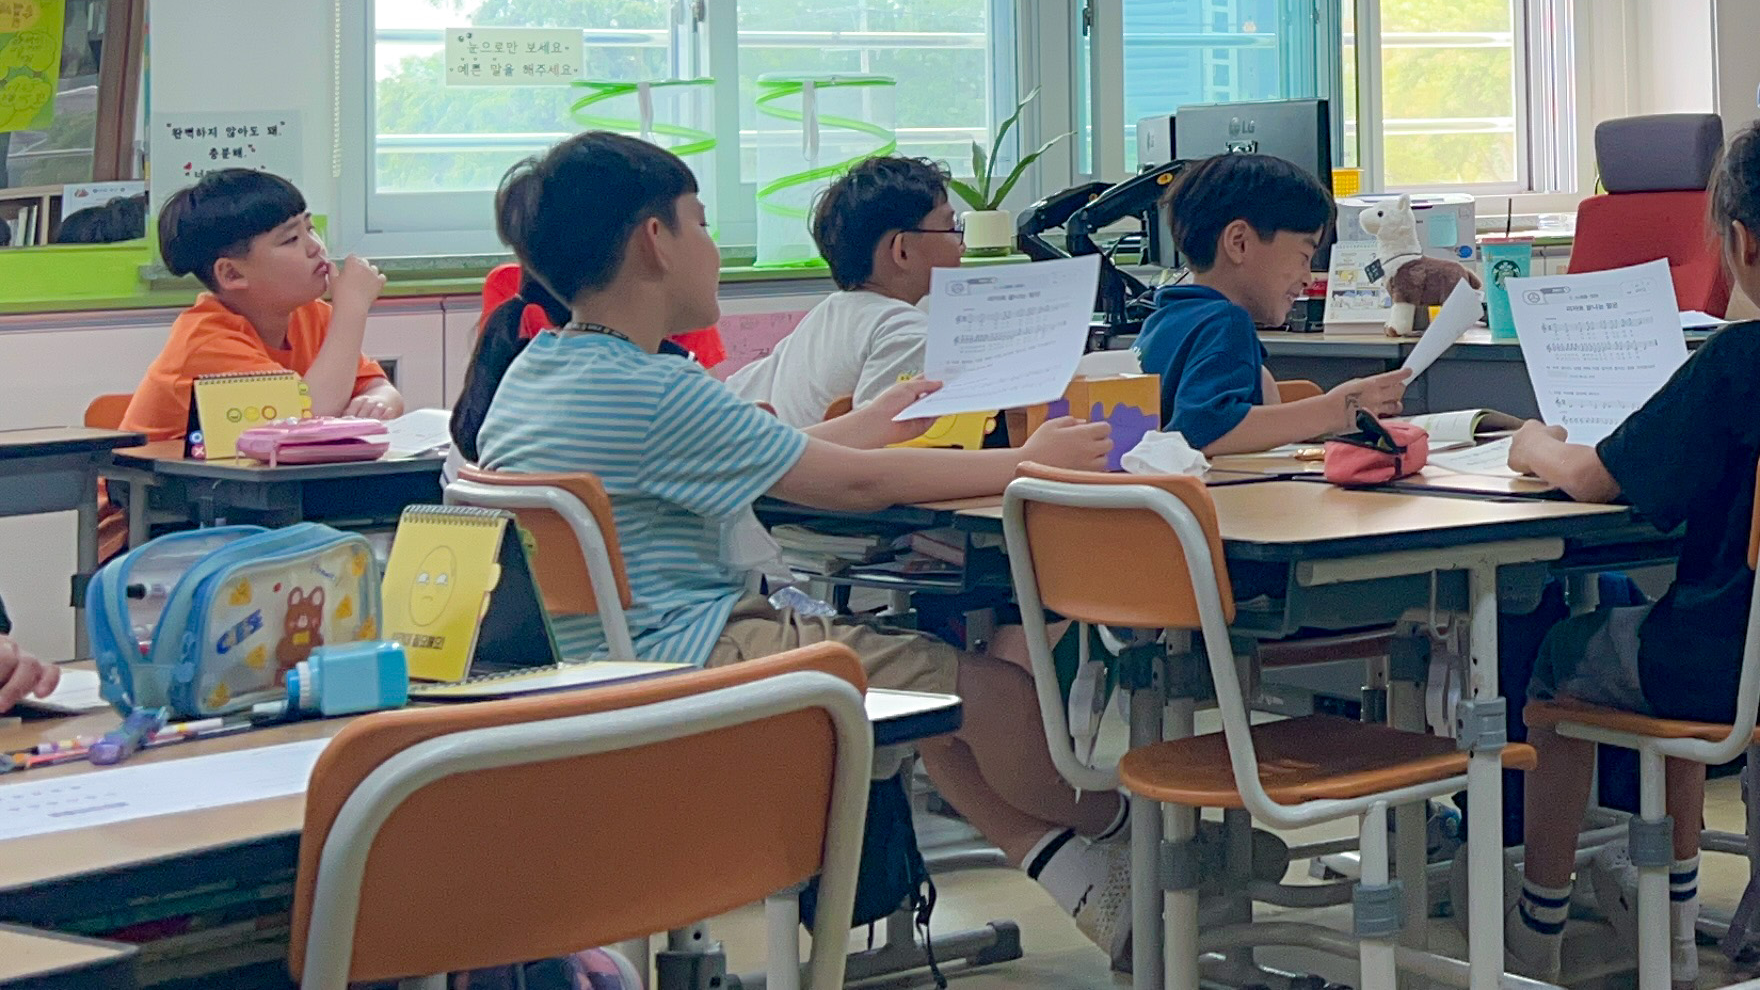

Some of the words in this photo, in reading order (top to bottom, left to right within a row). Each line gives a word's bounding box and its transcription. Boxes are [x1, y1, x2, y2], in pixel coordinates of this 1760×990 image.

[467, 41, 518, 55] 눈으로만
[490, 63, 515, 77] 말을
[1242, 120, 1255, 134] LG
